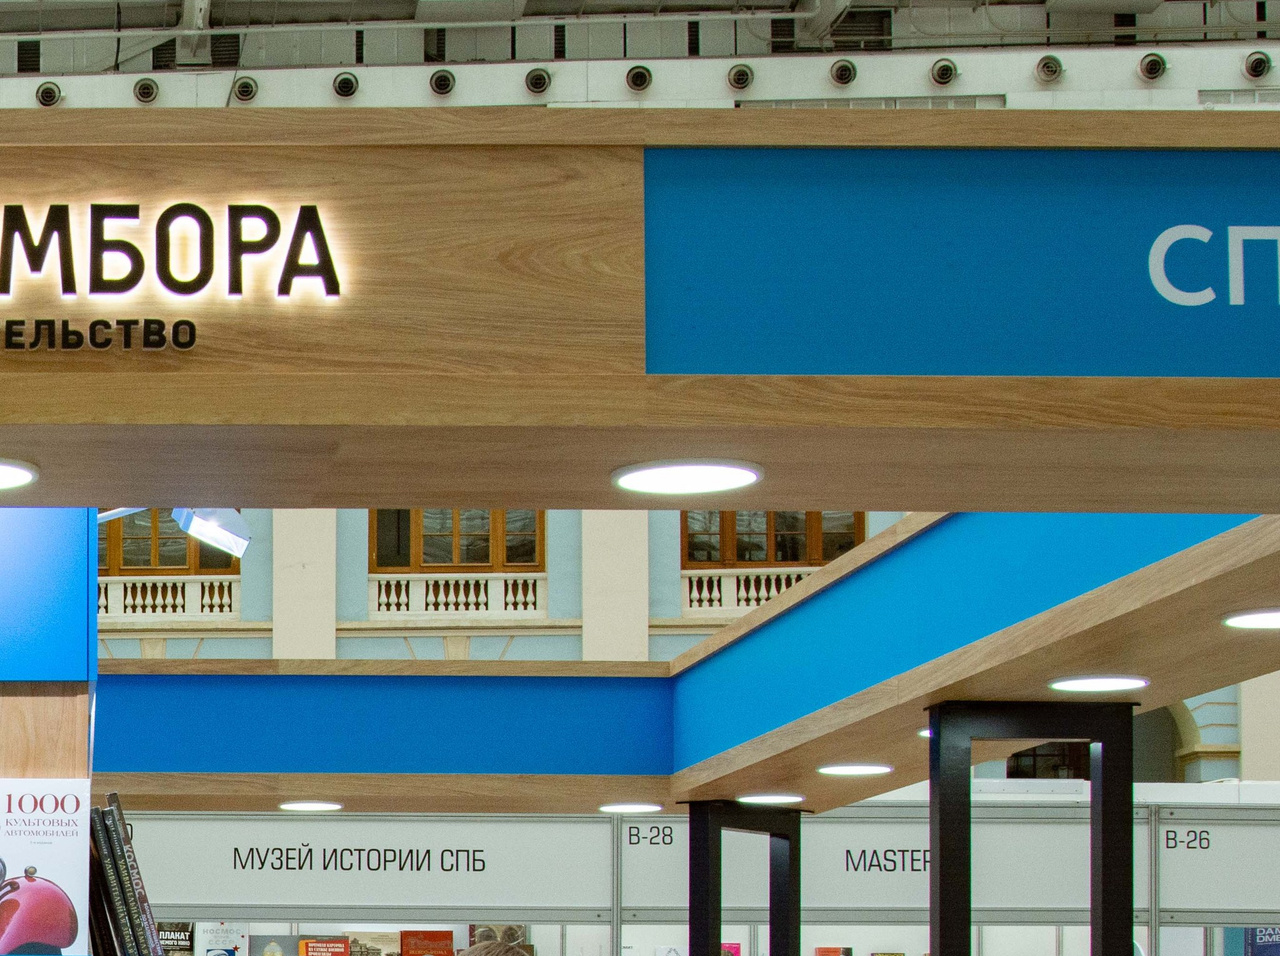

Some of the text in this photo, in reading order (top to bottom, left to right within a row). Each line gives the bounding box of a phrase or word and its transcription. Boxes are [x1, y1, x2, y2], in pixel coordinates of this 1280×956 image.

[6, 793, 80, 815] 1000
[4, 828, 78, 837] АВТОМОБИЛЕЙ
[6, 818, 78, 827] КУЛЬТОВЫХ
[628, 826, 674, 846] B-28
[1165, 830, 1210, 850] B-26
[233, 843, 486, 872] МУЗЕЙ ИСТОРИИ СПБ
[124, 843, 146, 897] КОСМОС
[160, 931, 190, 940] ПЛАКАТ
